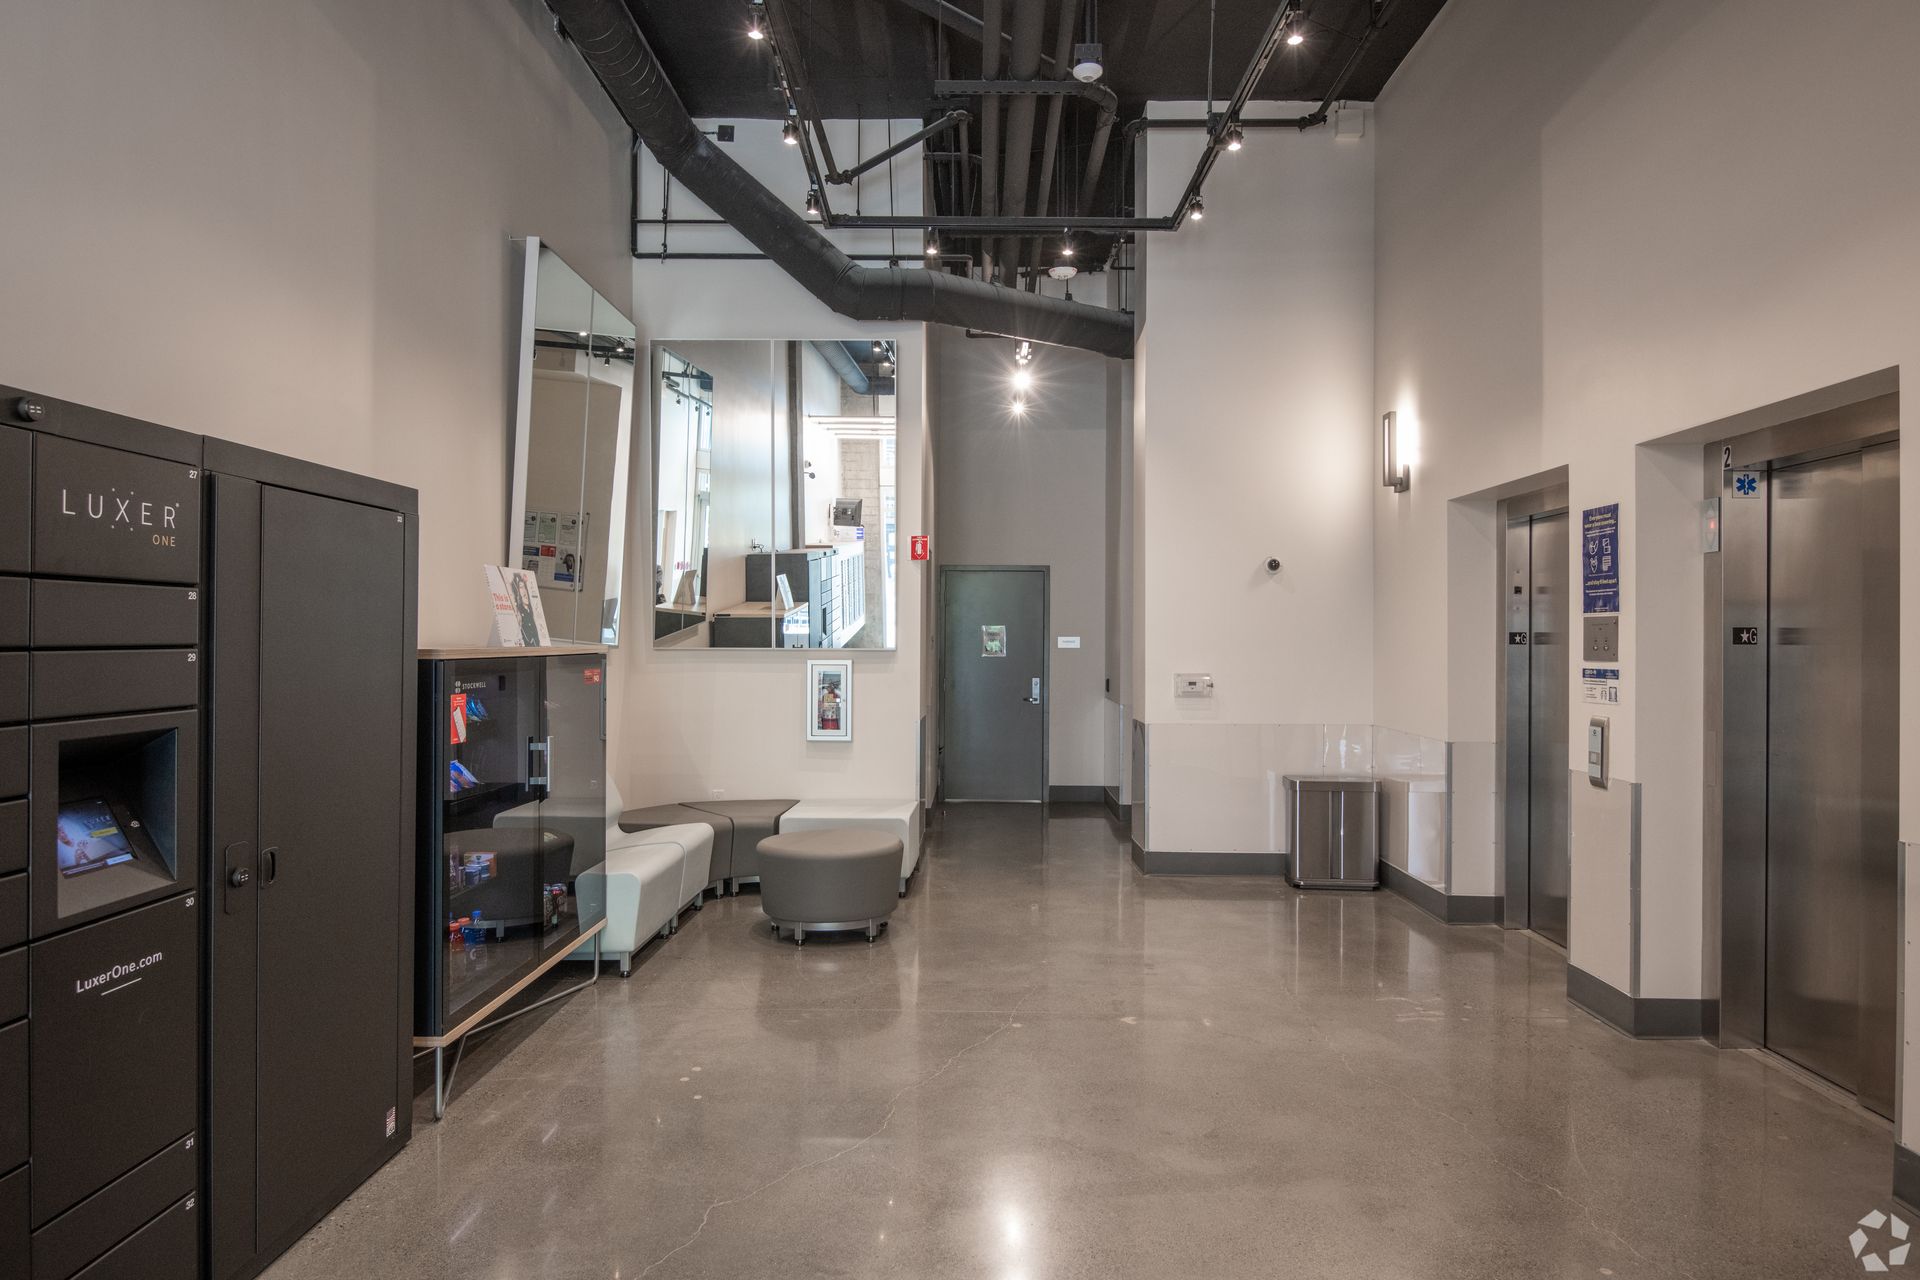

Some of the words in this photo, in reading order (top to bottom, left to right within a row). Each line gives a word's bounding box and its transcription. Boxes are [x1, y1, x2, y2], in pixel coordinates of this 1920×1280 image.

[1723, 446, 1731, 469] 2
[188, 469, 198, 479] 27
[62, 488, 177, 530] LUXER
[152, 534, 176, 547] ONE
[188, 591, 197, 600] 28
[492, 592, 504, 602] This
[1750, 628, 1757, 644] G
[187, 653, 196, 662] 29
[462, 681, 487, 690] STOCKWELL
[185, 896, 195, 907] 30
[76, 951, 163, 993] LuxerOne.com
[185, 1137, 194, 1149] 31
[185, 1198, 195, 1210] 32
